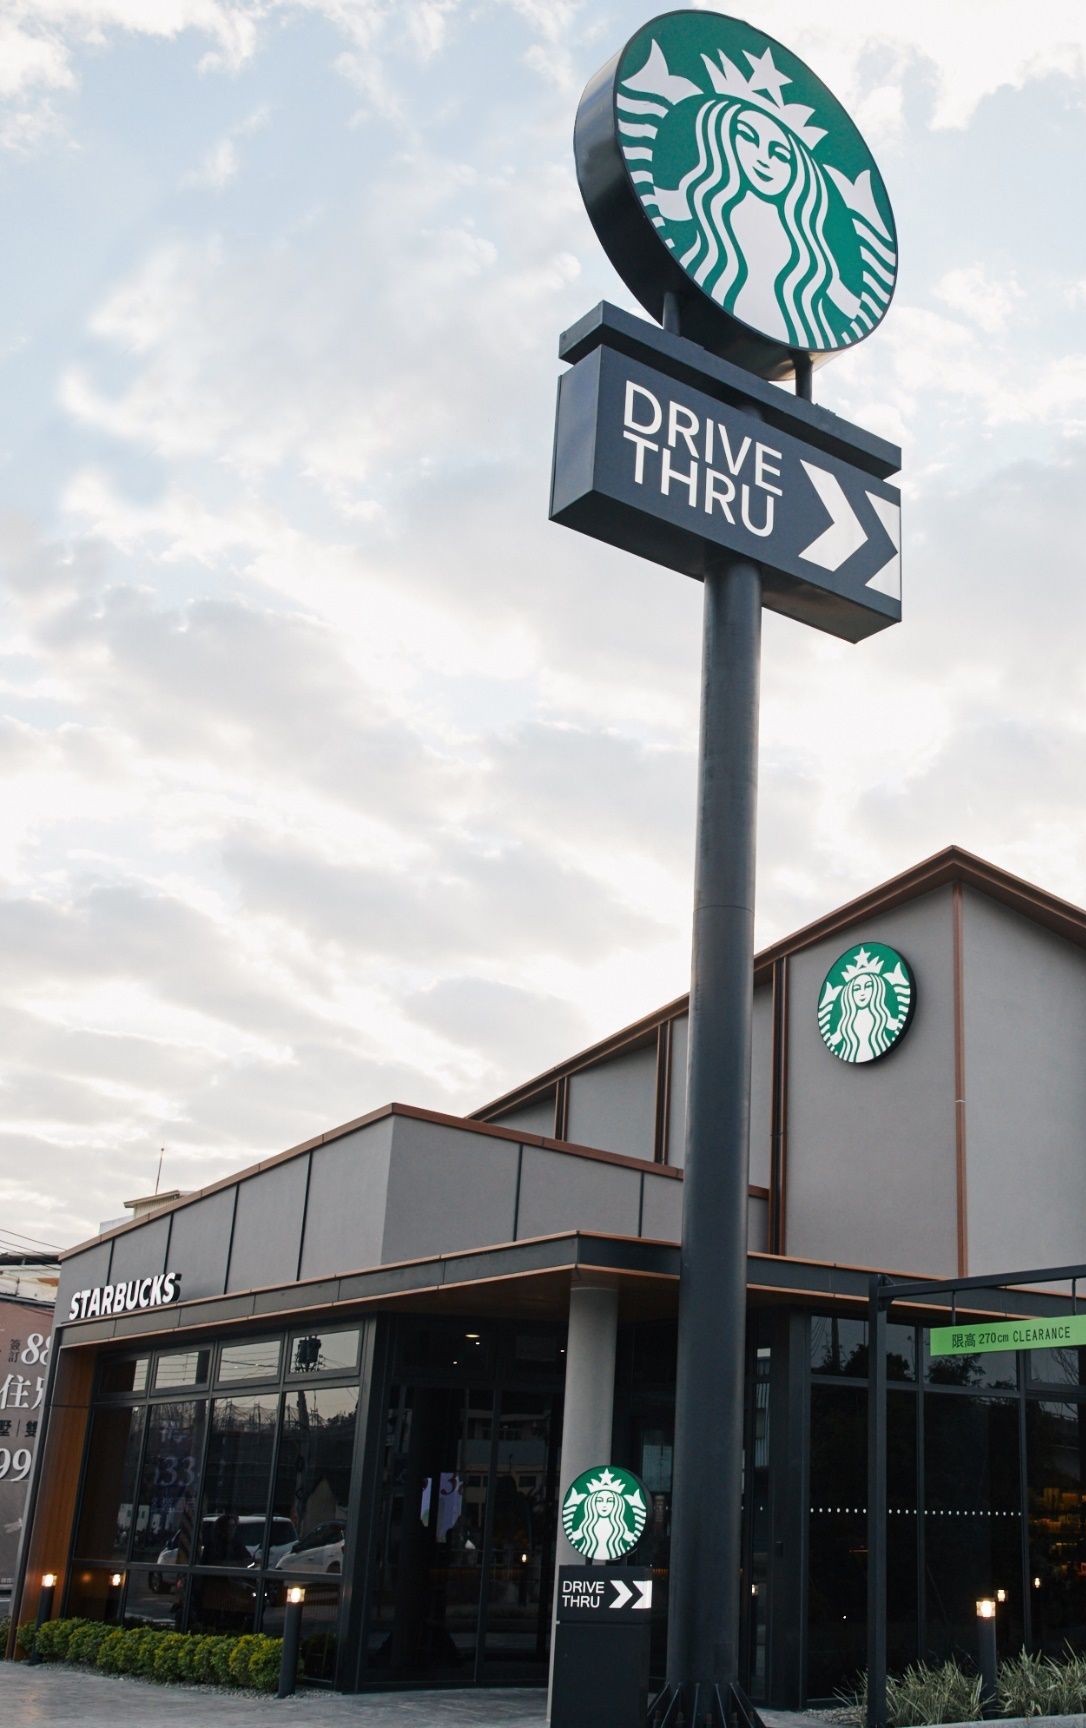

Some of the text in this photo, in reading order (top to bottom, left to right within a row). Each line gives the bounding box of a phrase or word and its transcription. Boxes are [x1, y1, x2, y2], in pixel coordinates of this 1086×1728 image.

[623, 380, 783, 496] DRIVE
[623, 430, 775, 537] THRU
[69, 1272, 176, 1320] STARBUCKS
[952, 1326, 1071, 1348] 限高 270cm CLEARANCE
[0, 1374, 46, 1410] 住
[562, 1580, 605, 1594] DRIVE
[562, 1595, 601, 1609] THRU
